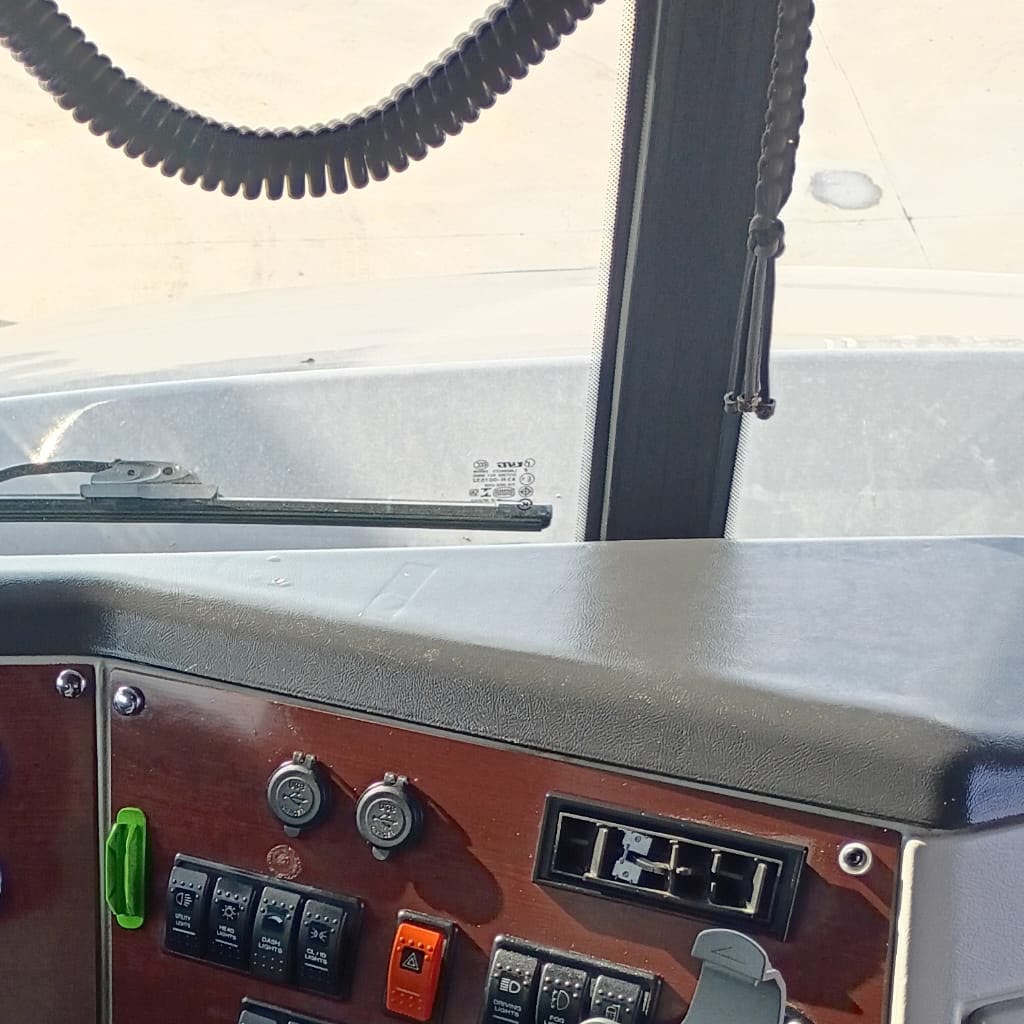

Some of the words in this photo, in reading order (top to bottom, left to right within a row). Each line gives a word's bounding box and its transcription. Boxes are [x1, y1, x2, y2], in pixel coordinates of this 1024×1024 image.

[219, 925, 235, 934] HEAD
[216, 930, 237, 941] LIGHTS
[261, 936, 281, 947] DASH
[258, 943, 283, 954] LIGHTS
[304, 953, 328, 965] LIGHTS
[493, 999, 522, 1013] DRIVING
[494, 1006, 520, 1018] LIGHTS
[549, 1015, 566, 1024] FOG
